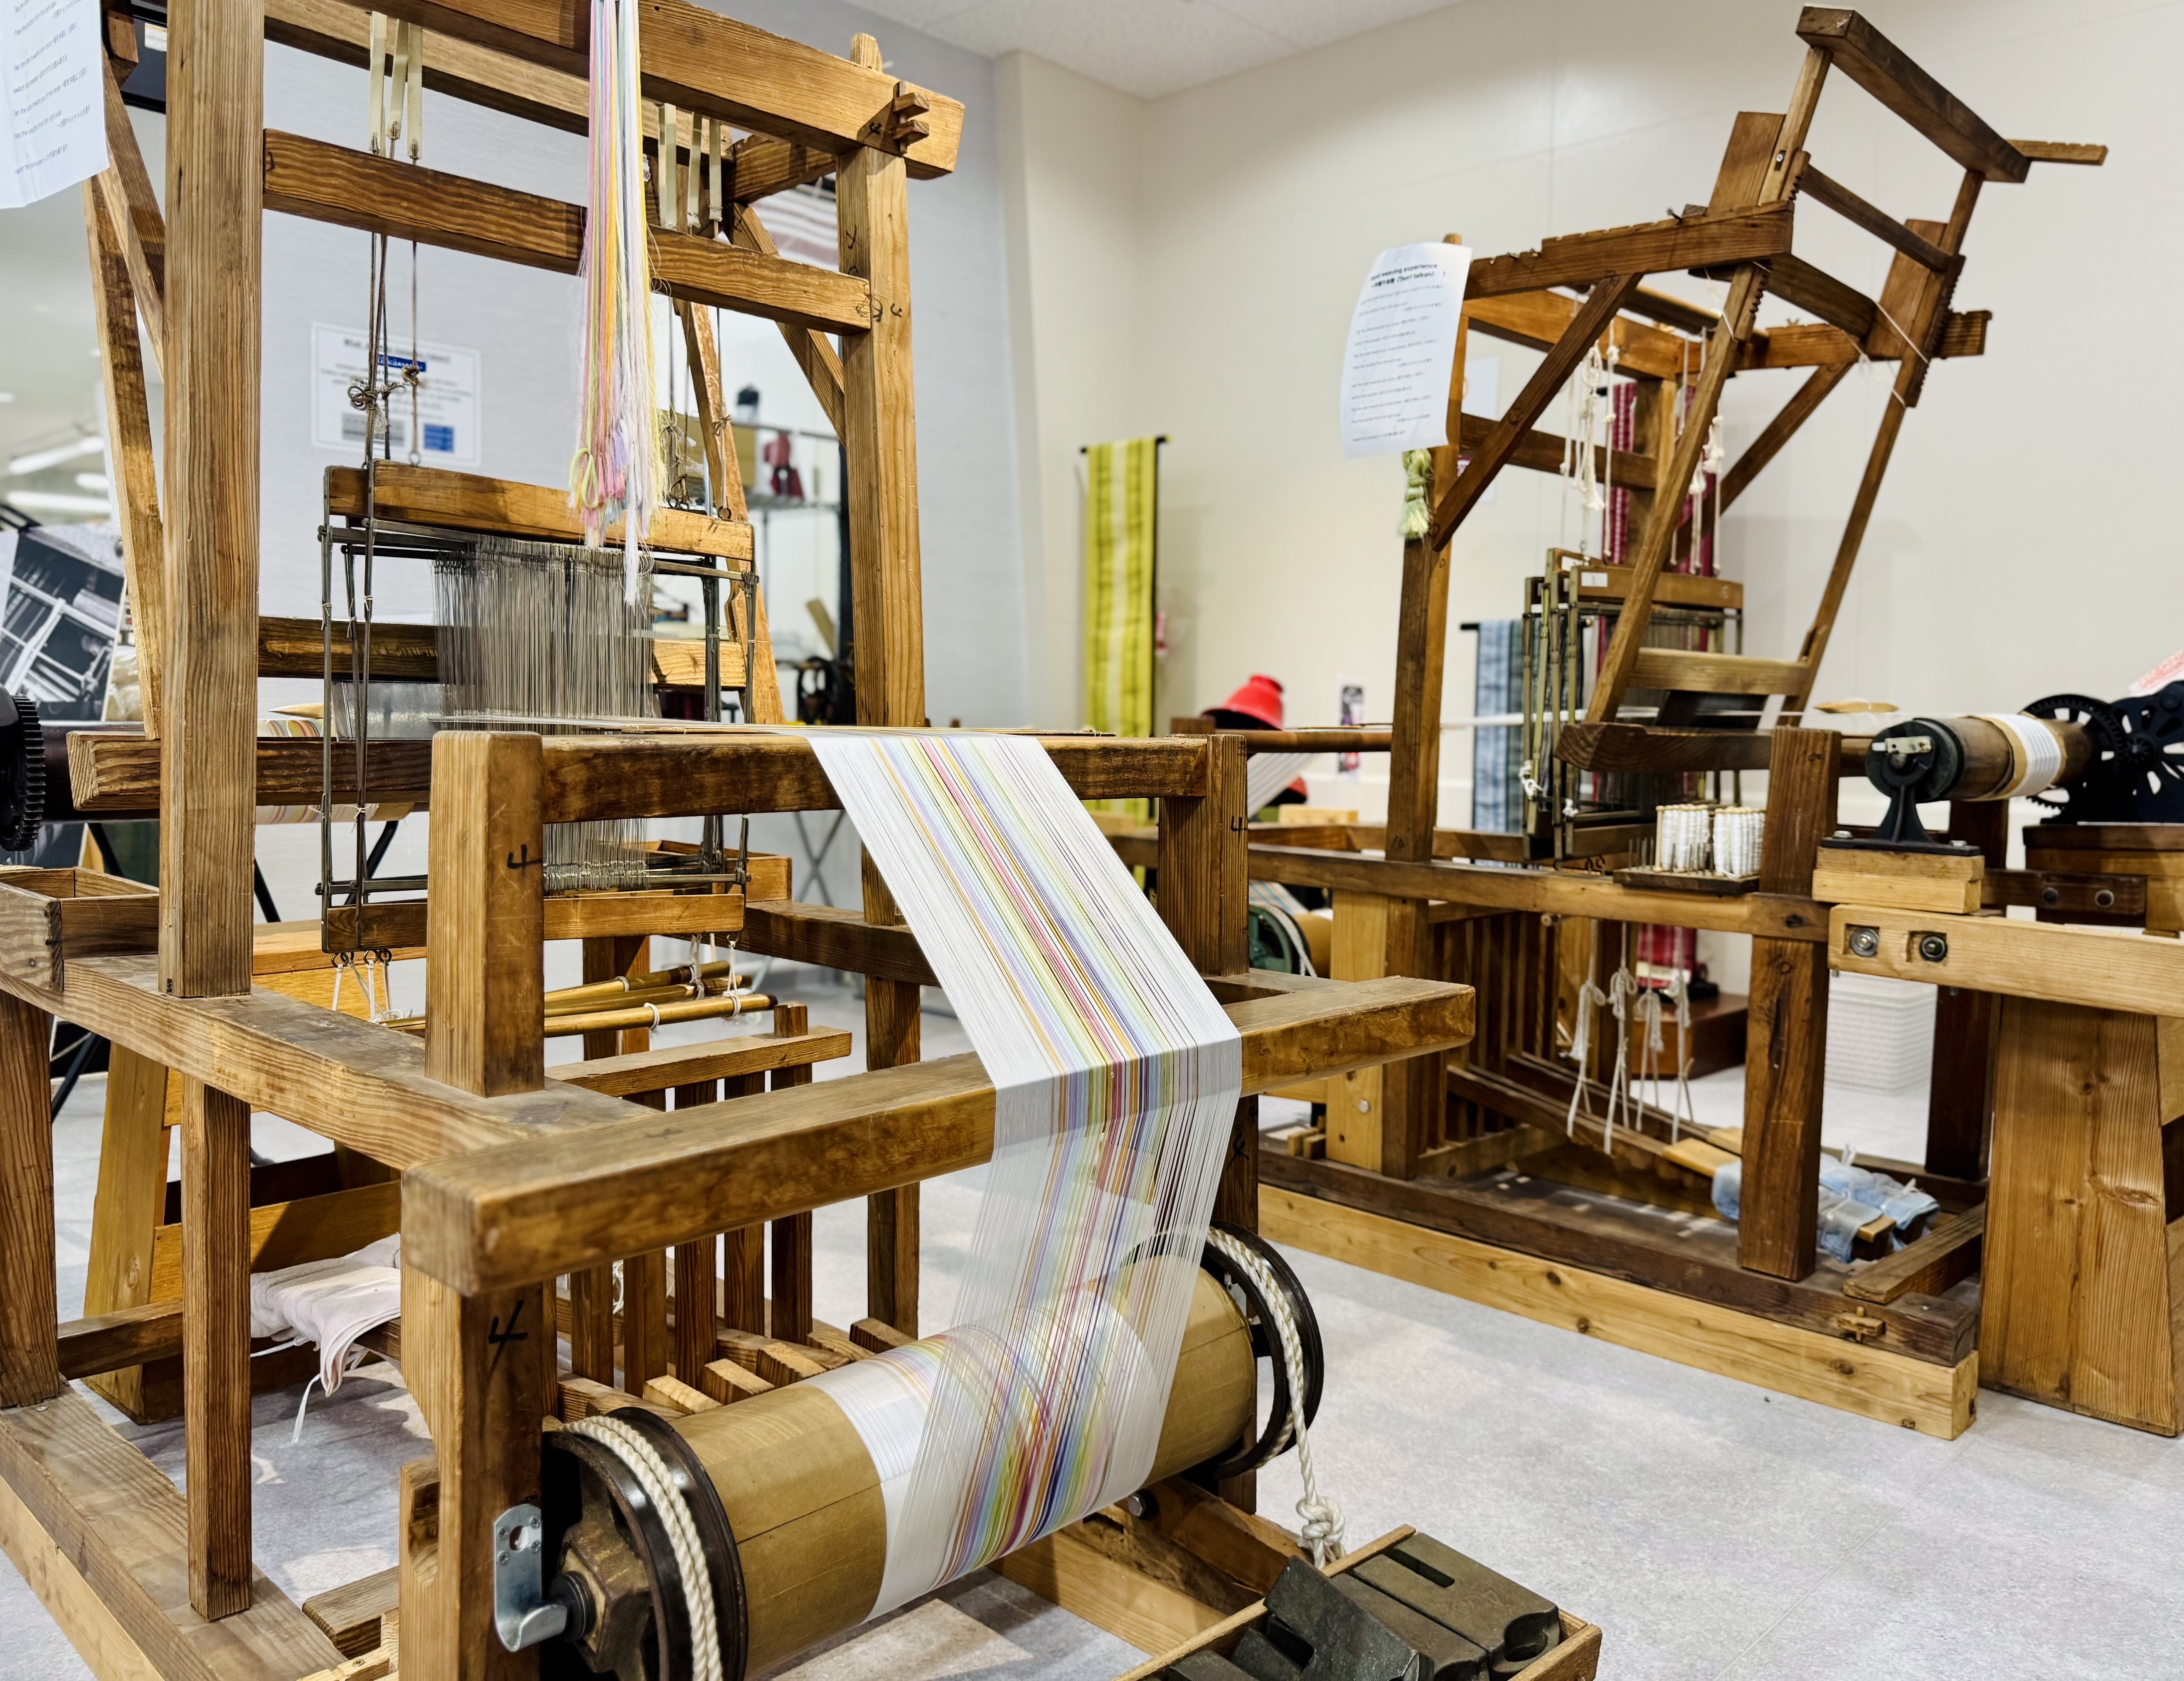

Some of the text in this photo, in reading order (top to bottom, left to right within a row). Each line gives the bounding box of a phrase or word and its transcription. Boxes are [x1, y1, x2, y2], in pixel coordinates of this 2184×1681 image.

[1404, 263, 1437, 273] experience
[1230, 815, 1244, 839] 4
[507, 844, 543, 875] 4
[488, 1300, 528, 1376] 4
